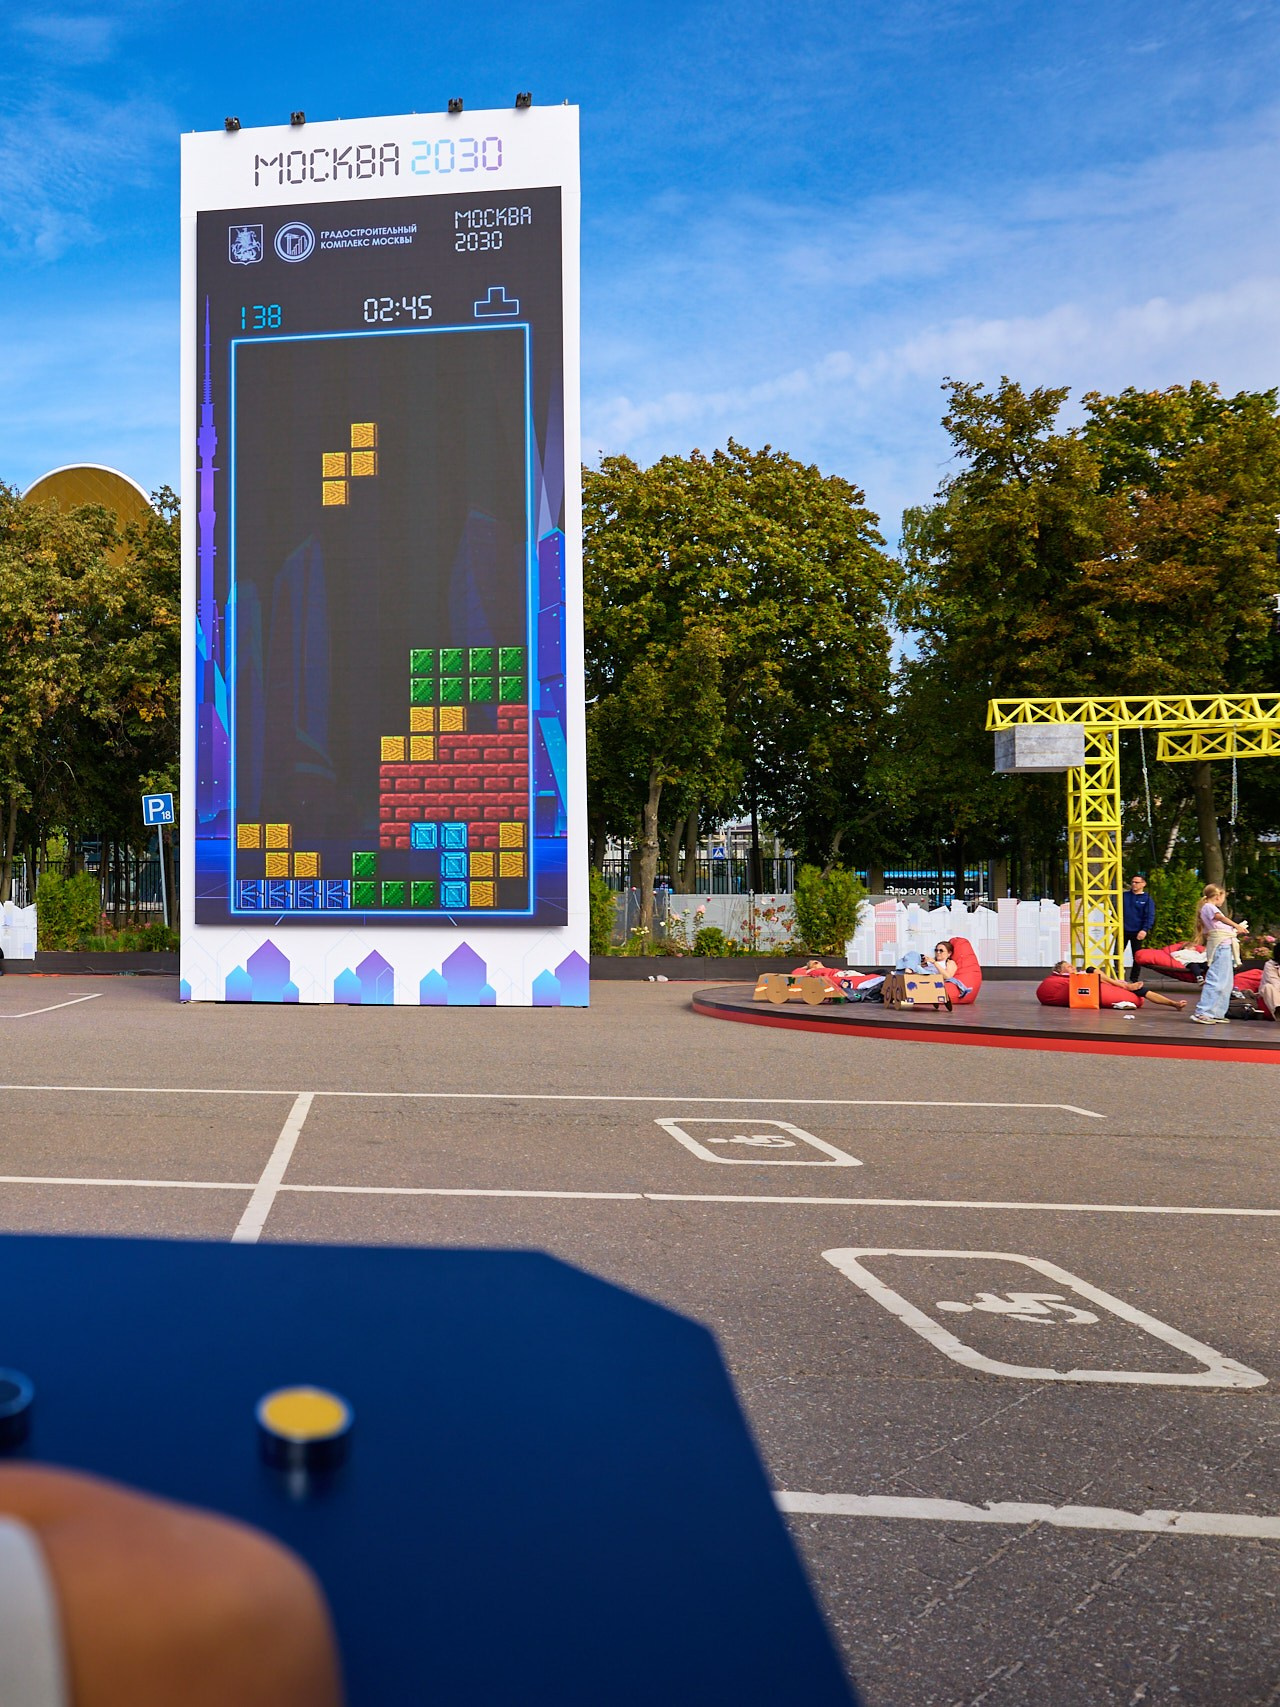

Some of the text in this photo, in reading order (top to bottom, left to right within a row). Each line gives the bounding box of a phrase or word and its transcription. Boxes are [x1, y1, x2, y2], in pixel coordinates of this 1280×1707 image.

[254, 136, 503, 186] МОСКВА 2030
[454, 206, 532, 229] МОСКВА
[320, 224, 418, 239] ГРАДОСТРОИТЕЛЬНЫЙ
[320, 236, 413, 250] КОМПЛЕКС МОСКВЫ
[455, 231, 503, 252] 2030
[241, 304, 283, 330] 138
[363, 295, 433, 323] 02:45
[148, 798, 172, 821] P 18
